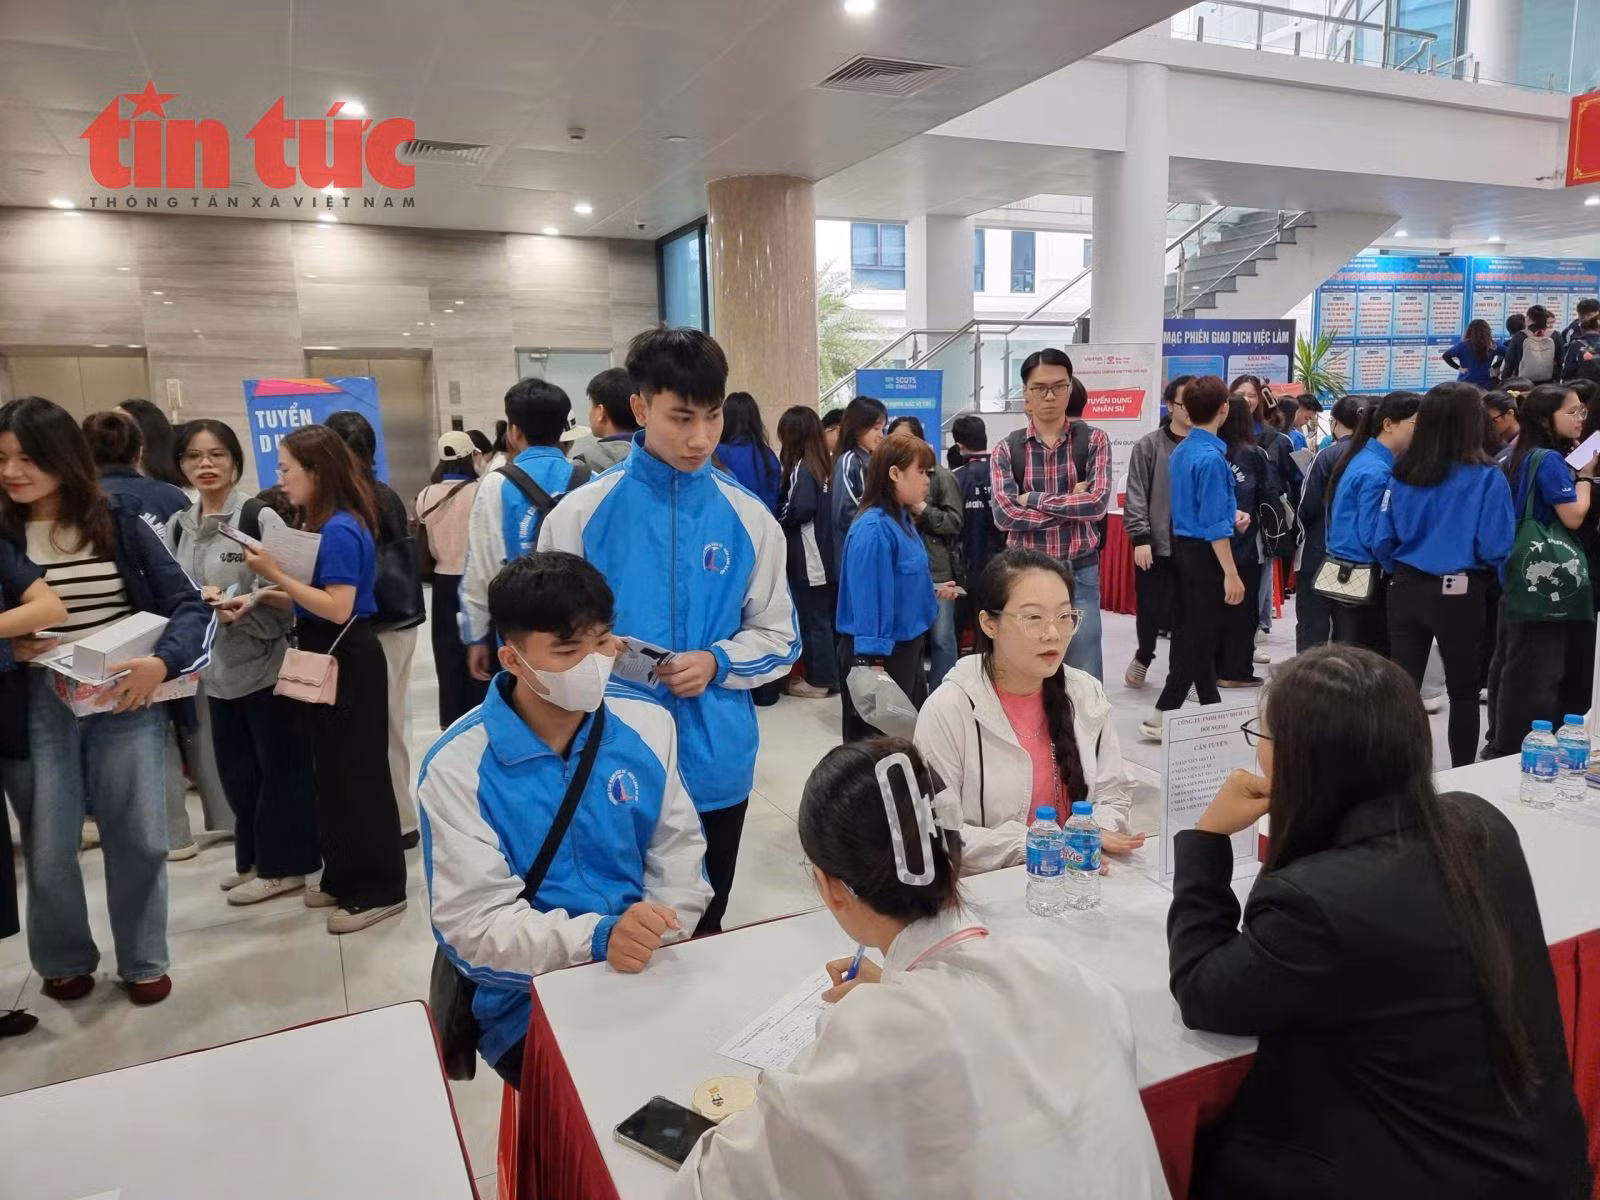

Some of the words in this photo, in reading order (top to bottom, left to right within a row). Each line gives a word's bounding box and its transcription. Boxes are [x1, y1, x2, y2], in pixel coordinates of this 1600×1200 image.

[1163, 331, 1182, 347] MẠC
[1185, 328, 1210, 344] PHIÊN
[1212, 331, 1230, 344] GIAO
[1232, 331, 1251, 347] DỊCH
[1253, 328, 1271, 347] VIỆC
[1272, 329, 1289, 343] LÀM
[895, 376, 917, 384] SCOTS
[255, 402, 313, 429] TUYỂN
[1092, 405, 1114, 413] NHÂN
